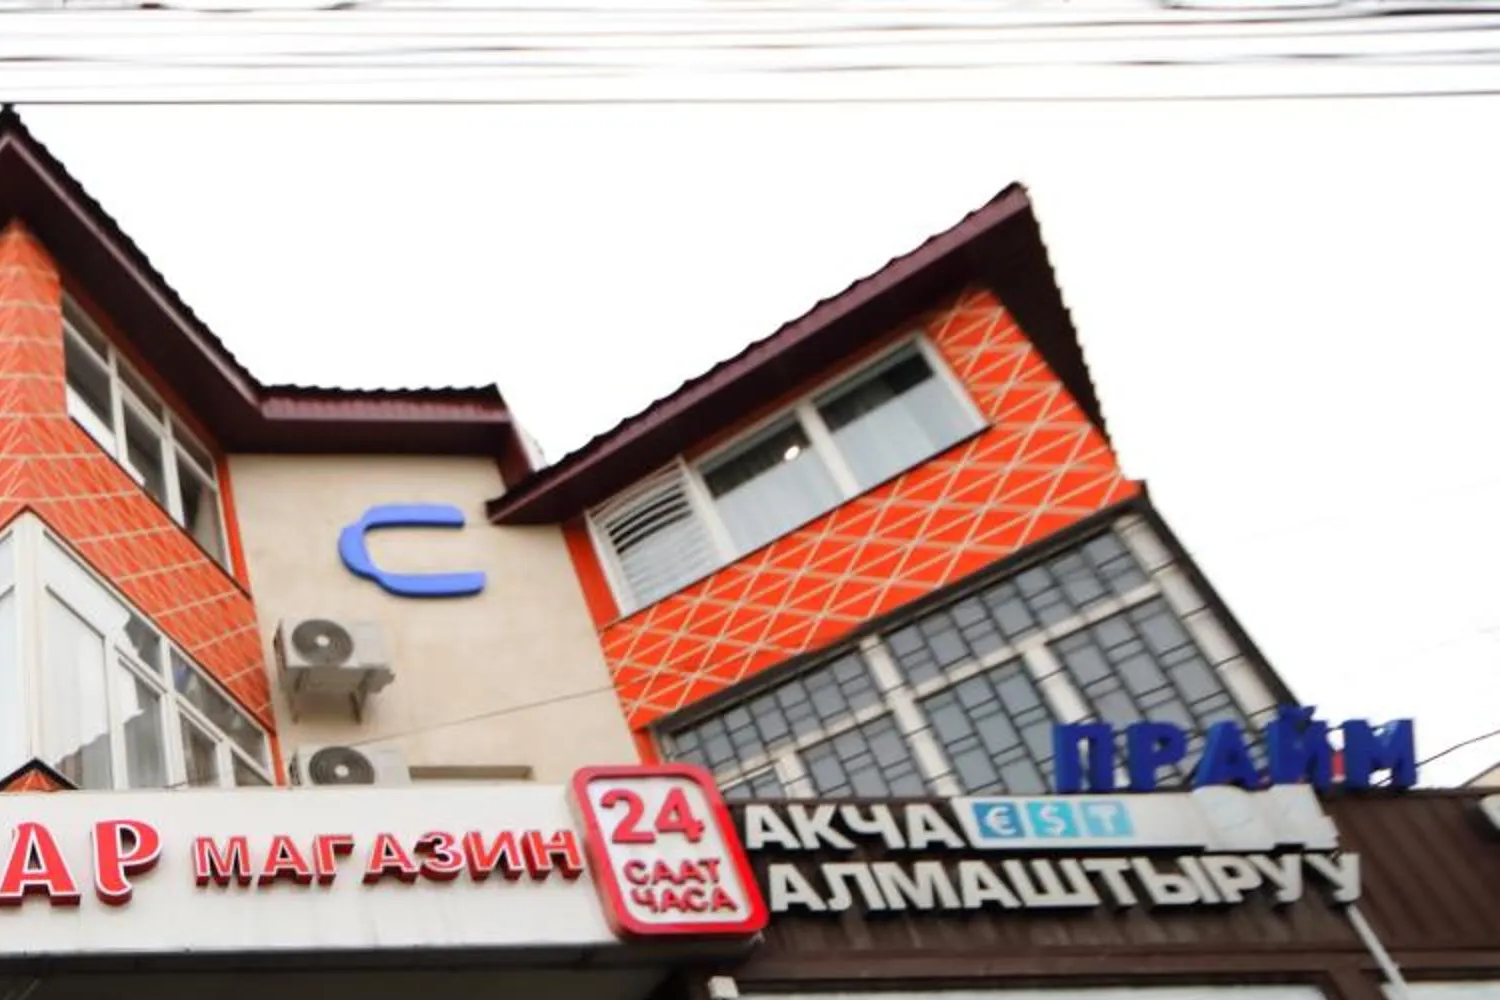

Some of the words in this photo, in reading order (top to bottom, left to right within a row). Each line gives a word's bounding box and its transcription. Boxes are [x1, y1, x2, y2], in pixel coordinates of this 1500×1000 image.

[1054, 704, 1416, 793] ПРАЙМ
[600, 786, 706, 844] 24
[744, 803, 967, 852] АКЧА
[195, 828, 585, 888] МАГАЗИН
[624, 857, 721, 886] СААТ
[766, 853, 1362, 912] АЛМАШТЫРУУ
[630, 886, 740, 914] ЧАСА
